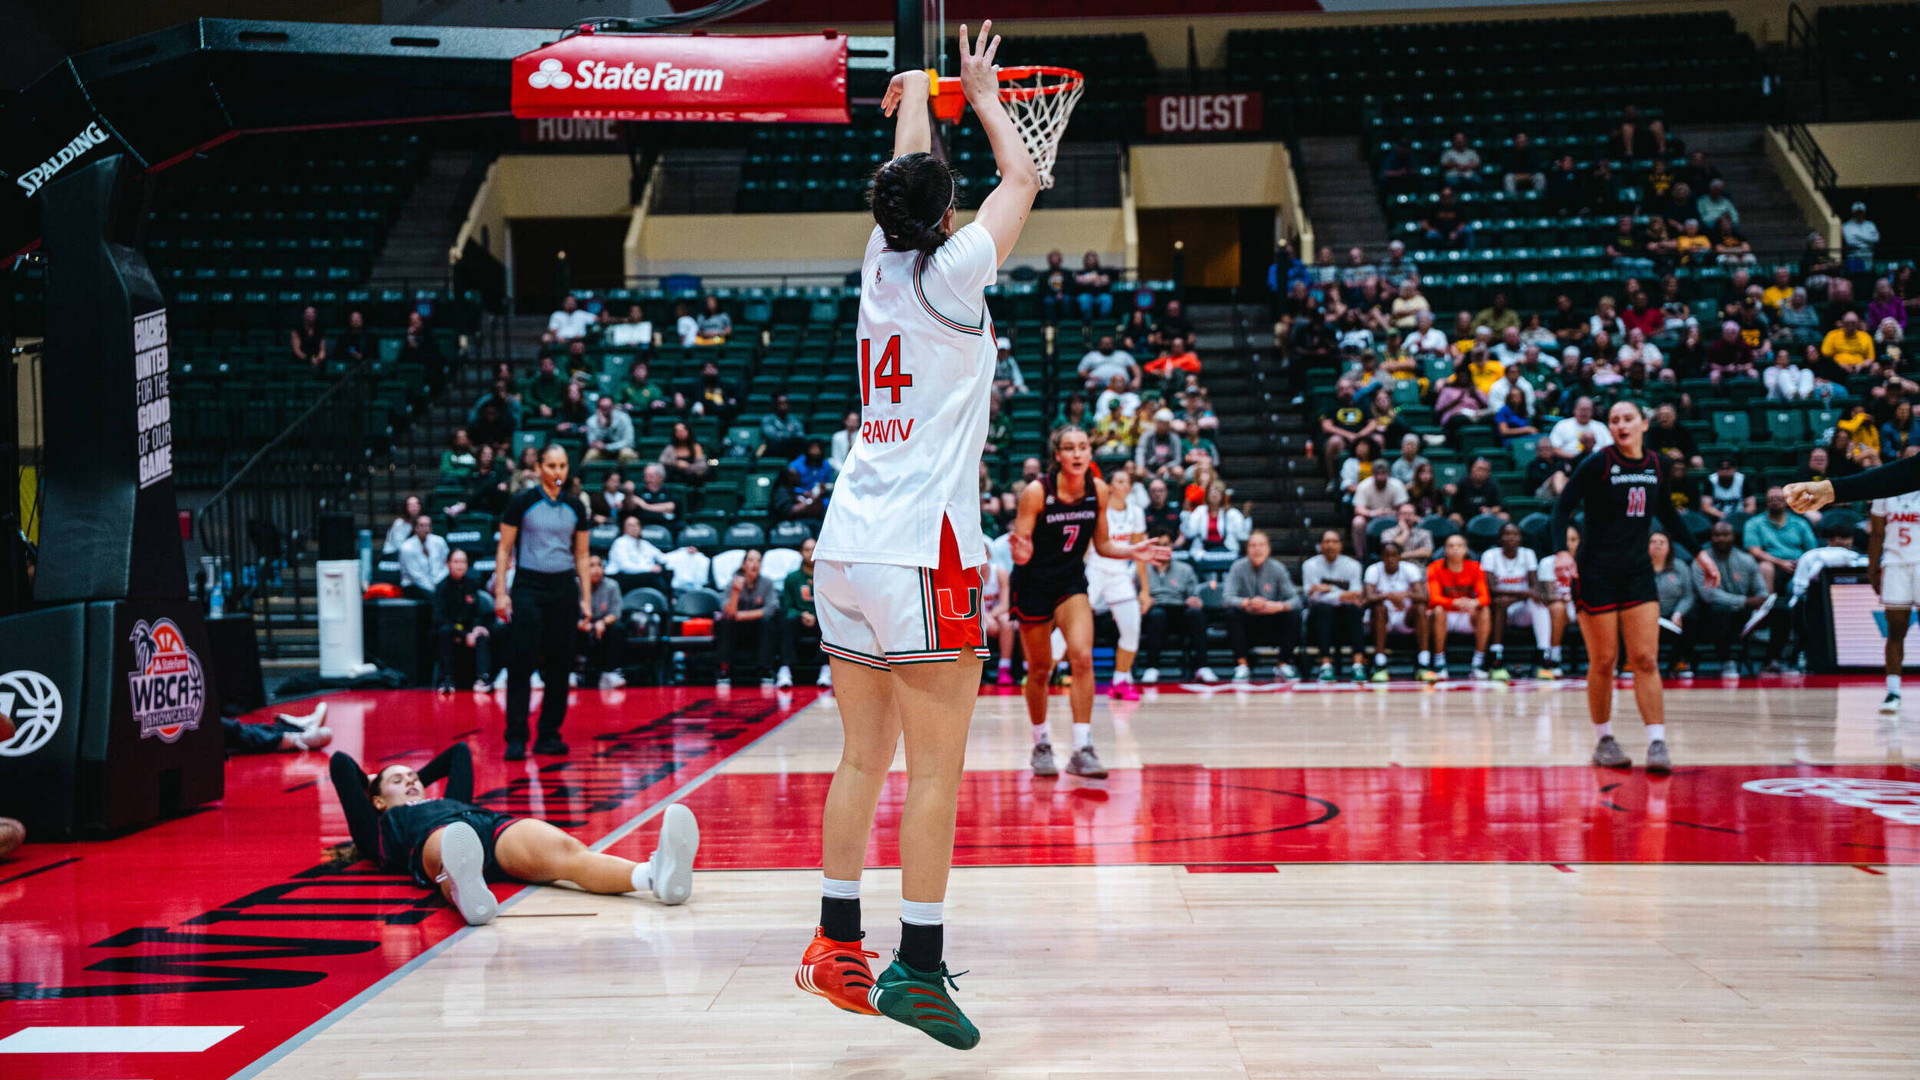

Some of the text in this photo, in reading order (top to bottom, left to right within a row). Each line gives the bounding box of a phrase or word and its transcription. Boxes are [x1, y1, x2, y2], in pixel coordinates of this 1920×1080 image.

[538, 118, 617, 140] HOME
[1161, 94, 1248, 131] GUEST
[17, 121, 110, 198] SPALDING
[135, 345, 168, 381] UNITED
[861, 335, 913, 406] 14
[137, 371, 170, 406] FOR THE
[138, 396, 170, 433] GOOD
[862, 418, 915, 443] RAVIV
[138, 422, 171, 456] OF OUR
[139, 444, 172, 483] GAME
[1626, 486, 1646, 517] 11
[1063, 524, 1080, 552] 7
[1898, 526, 1911, 547] 5
[937, 587, 978, 620] U
[132, 674, 189, 713] WBCA
